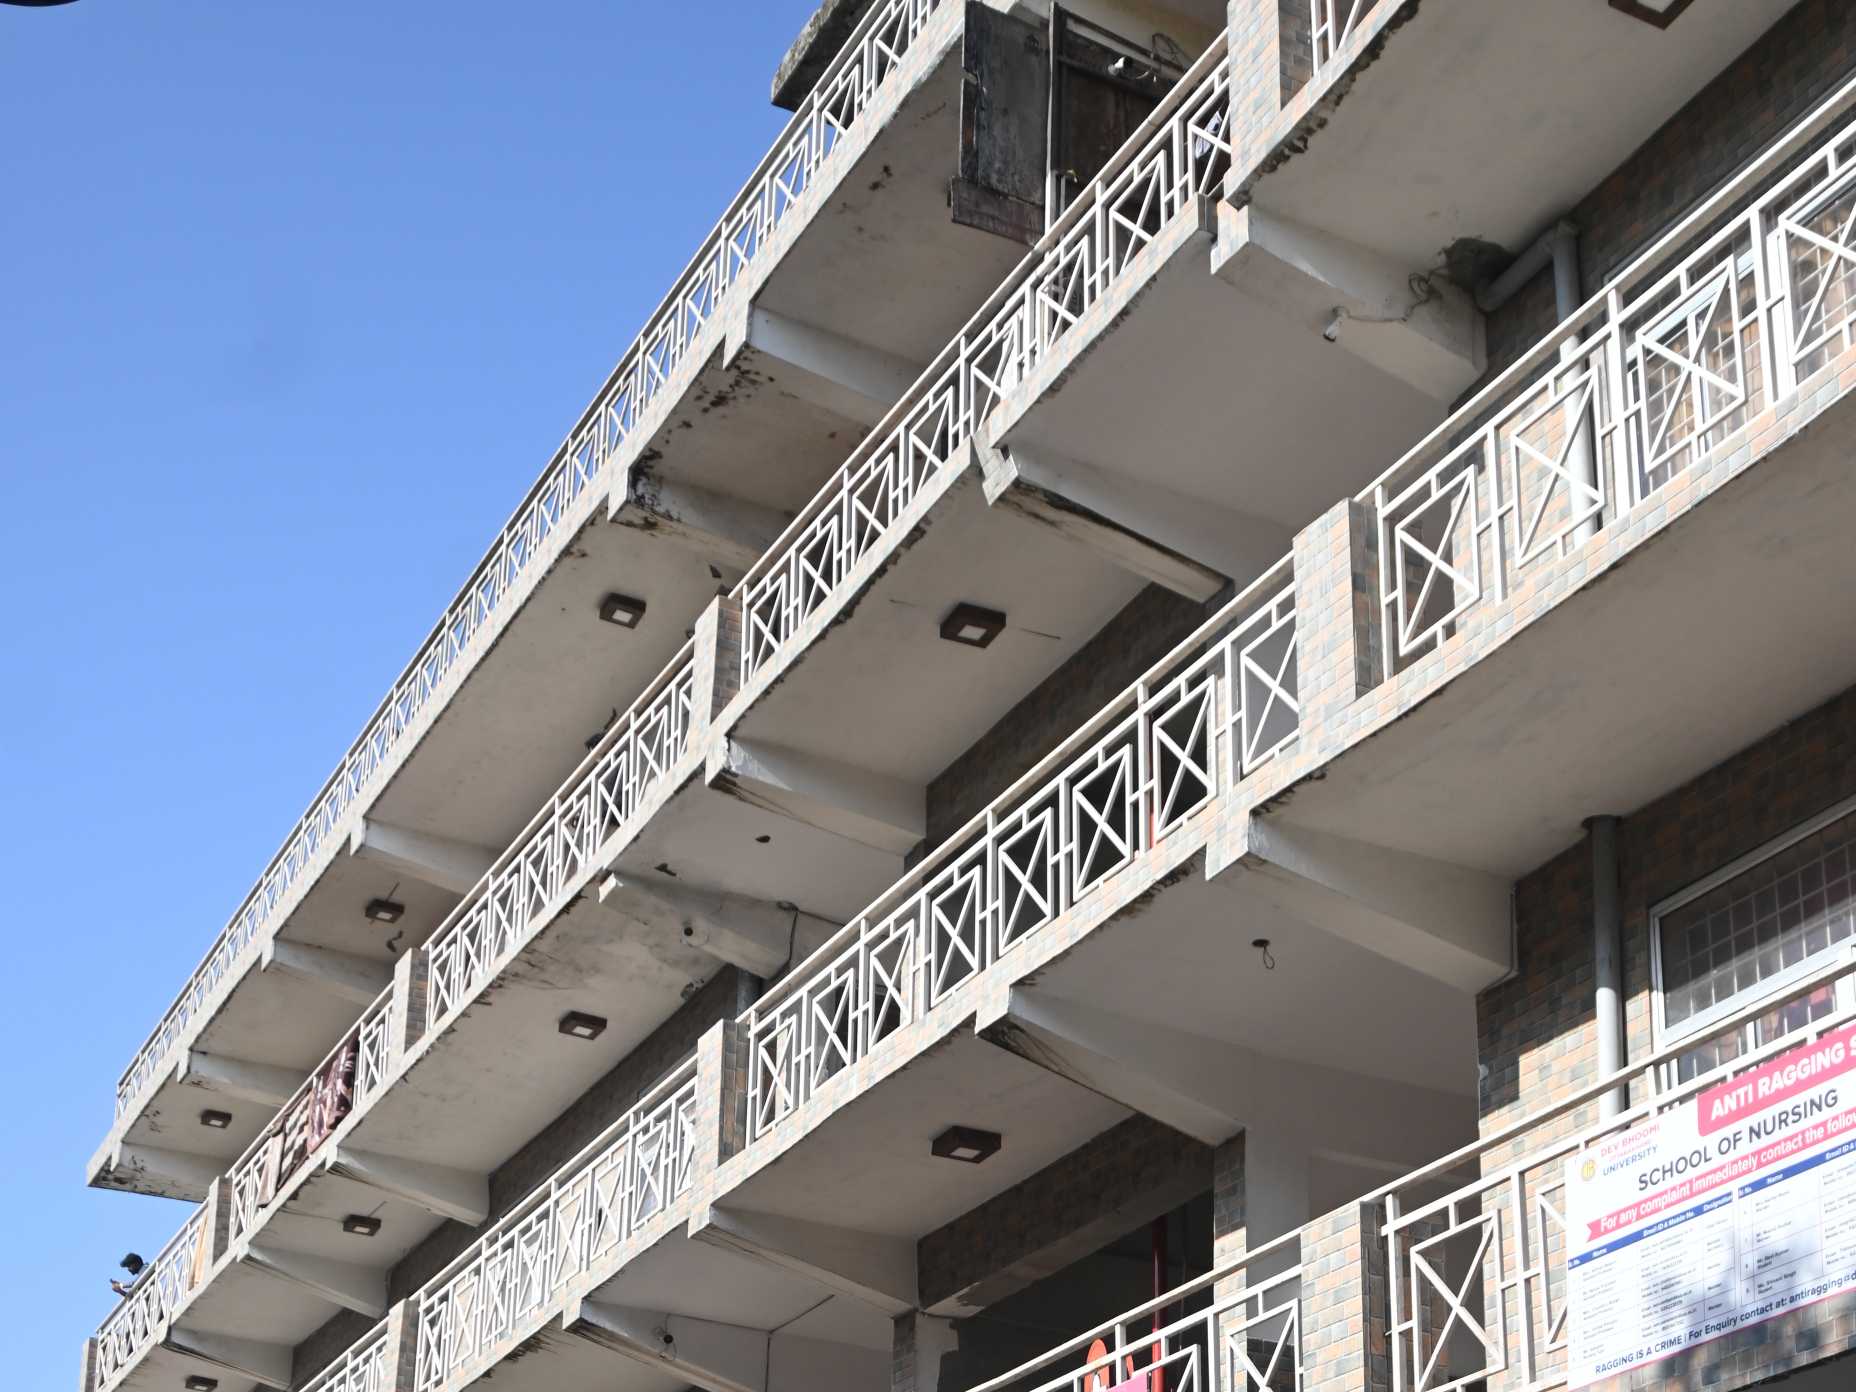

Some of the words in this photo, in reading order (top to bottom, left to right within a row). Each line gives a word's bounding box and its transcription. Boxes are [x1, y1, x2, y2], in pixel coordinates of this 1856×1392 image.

[1711, 1084, 1753, 1121] ANTI
[1758, 1042, 1846, 1100] RAGGING
[1600, 1141, 1619, 1157] DEV
[1622, 1123, 1660, 1147] BHOOMI
[1602, 1144, 1658, 1176] UNIVERSITY
[1638, 1145, 1712, 1191] SCHOOL
[1718, 1131, 1742, 1156] OF
[1748, 1089, 1839, 1143] NURSING
[1600, 1214, 1618, 1232] For
[1620, 1208, 1637, 1225] any
[1640, 1184, 1690, 1213] complaint
[1693, 1151, 1758, 1193] immediately
[1760, 1137, 1803, 1163] contact
[1804, 1126, 1824, 1144] the
[1595, 1353, 1634, 1374] RAGGING
[1636, 1349, 1644, 1360] IS
[1646, 1346, 1653, 1356] A
[1654, 1334, 1682, 1353] CRIME
[1688, 1329, 1703, 1341] For
[1705, 1315, 1738, 1335] Enquiry
[1740, 1301, 1773, 1321] contact
[1775, 1298, 1787, 1309] at:
